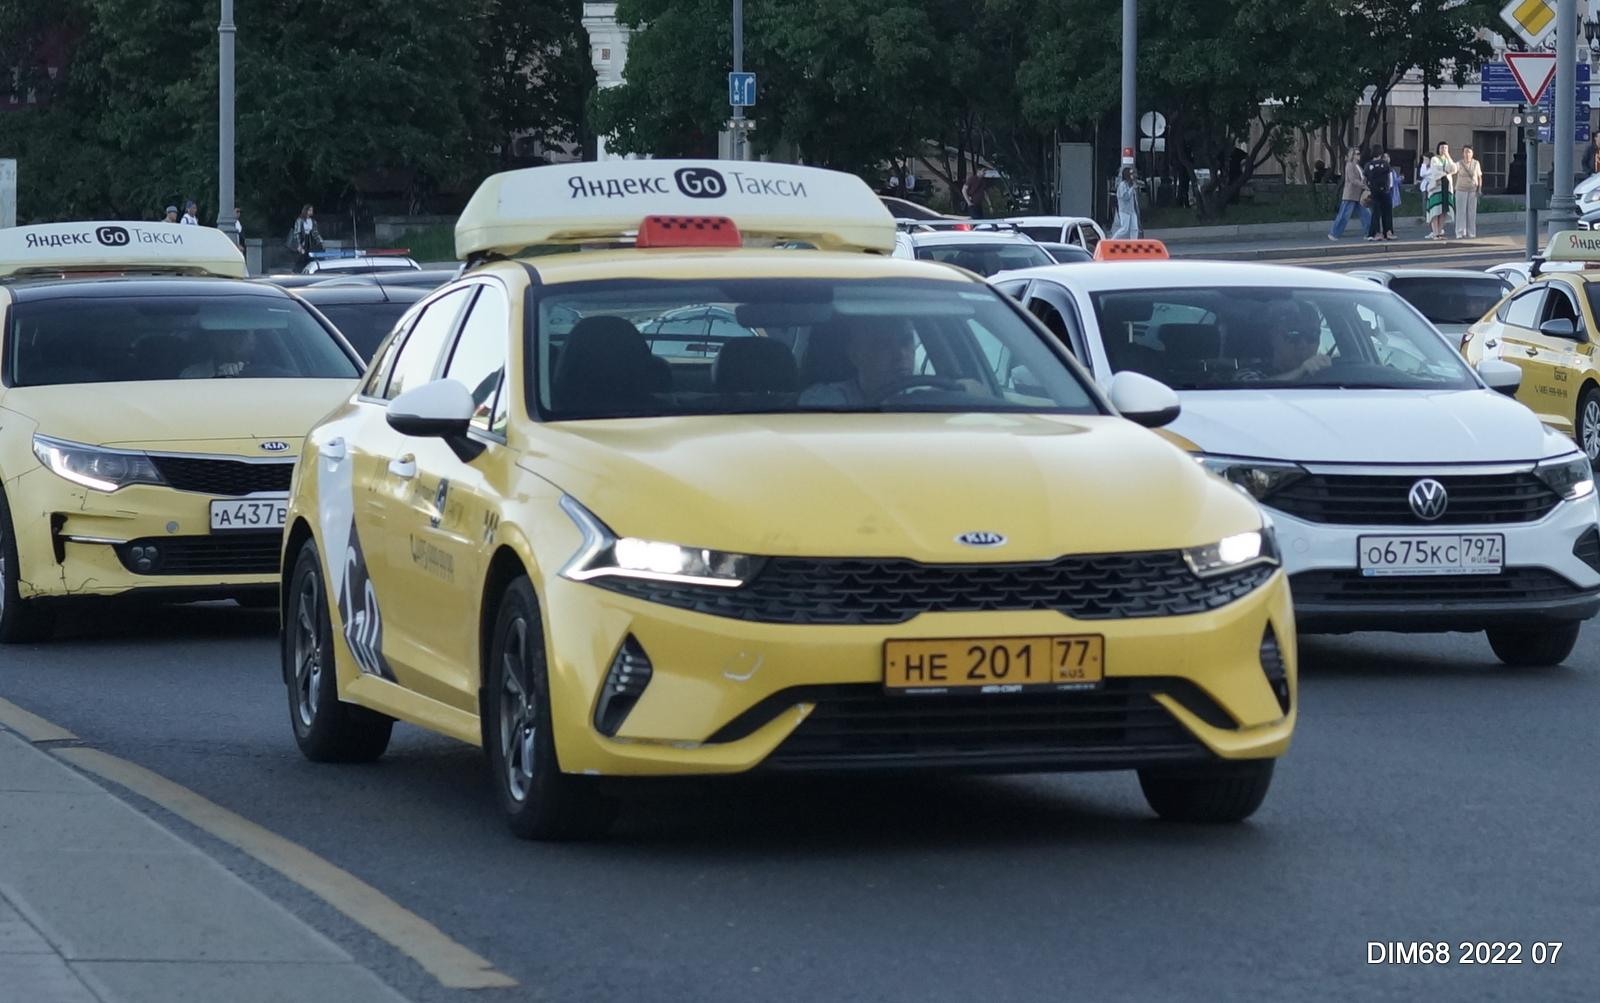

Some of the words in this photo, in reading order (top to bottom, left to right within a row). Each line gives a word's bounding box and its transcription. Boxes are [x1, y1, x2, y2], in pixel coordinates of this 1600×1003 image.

[568, 175, 669, 198] Яндекс
[680, 170, 721, 194] Go
[728, 171, 808, 198] Такси
[26, 231, 92, 248] Яндекс
[99, 227, 127, 244] Go
[130, 228, 184, 245] Такси
[262, 441, 287, 451] KIA
[964, 531, 1002, 544] KIA
[1368, 540, 1458, 564] О675КС
[1463, 538, 1497, 556] 797
[1471, 556, 1488, 564] RUS
[904, 654, 948, 681] НЕ
[966, 644, 1033, 679] 201
[1056, 640, 1090, 667] 77
[1059, 668, 1086, 679] RUS
